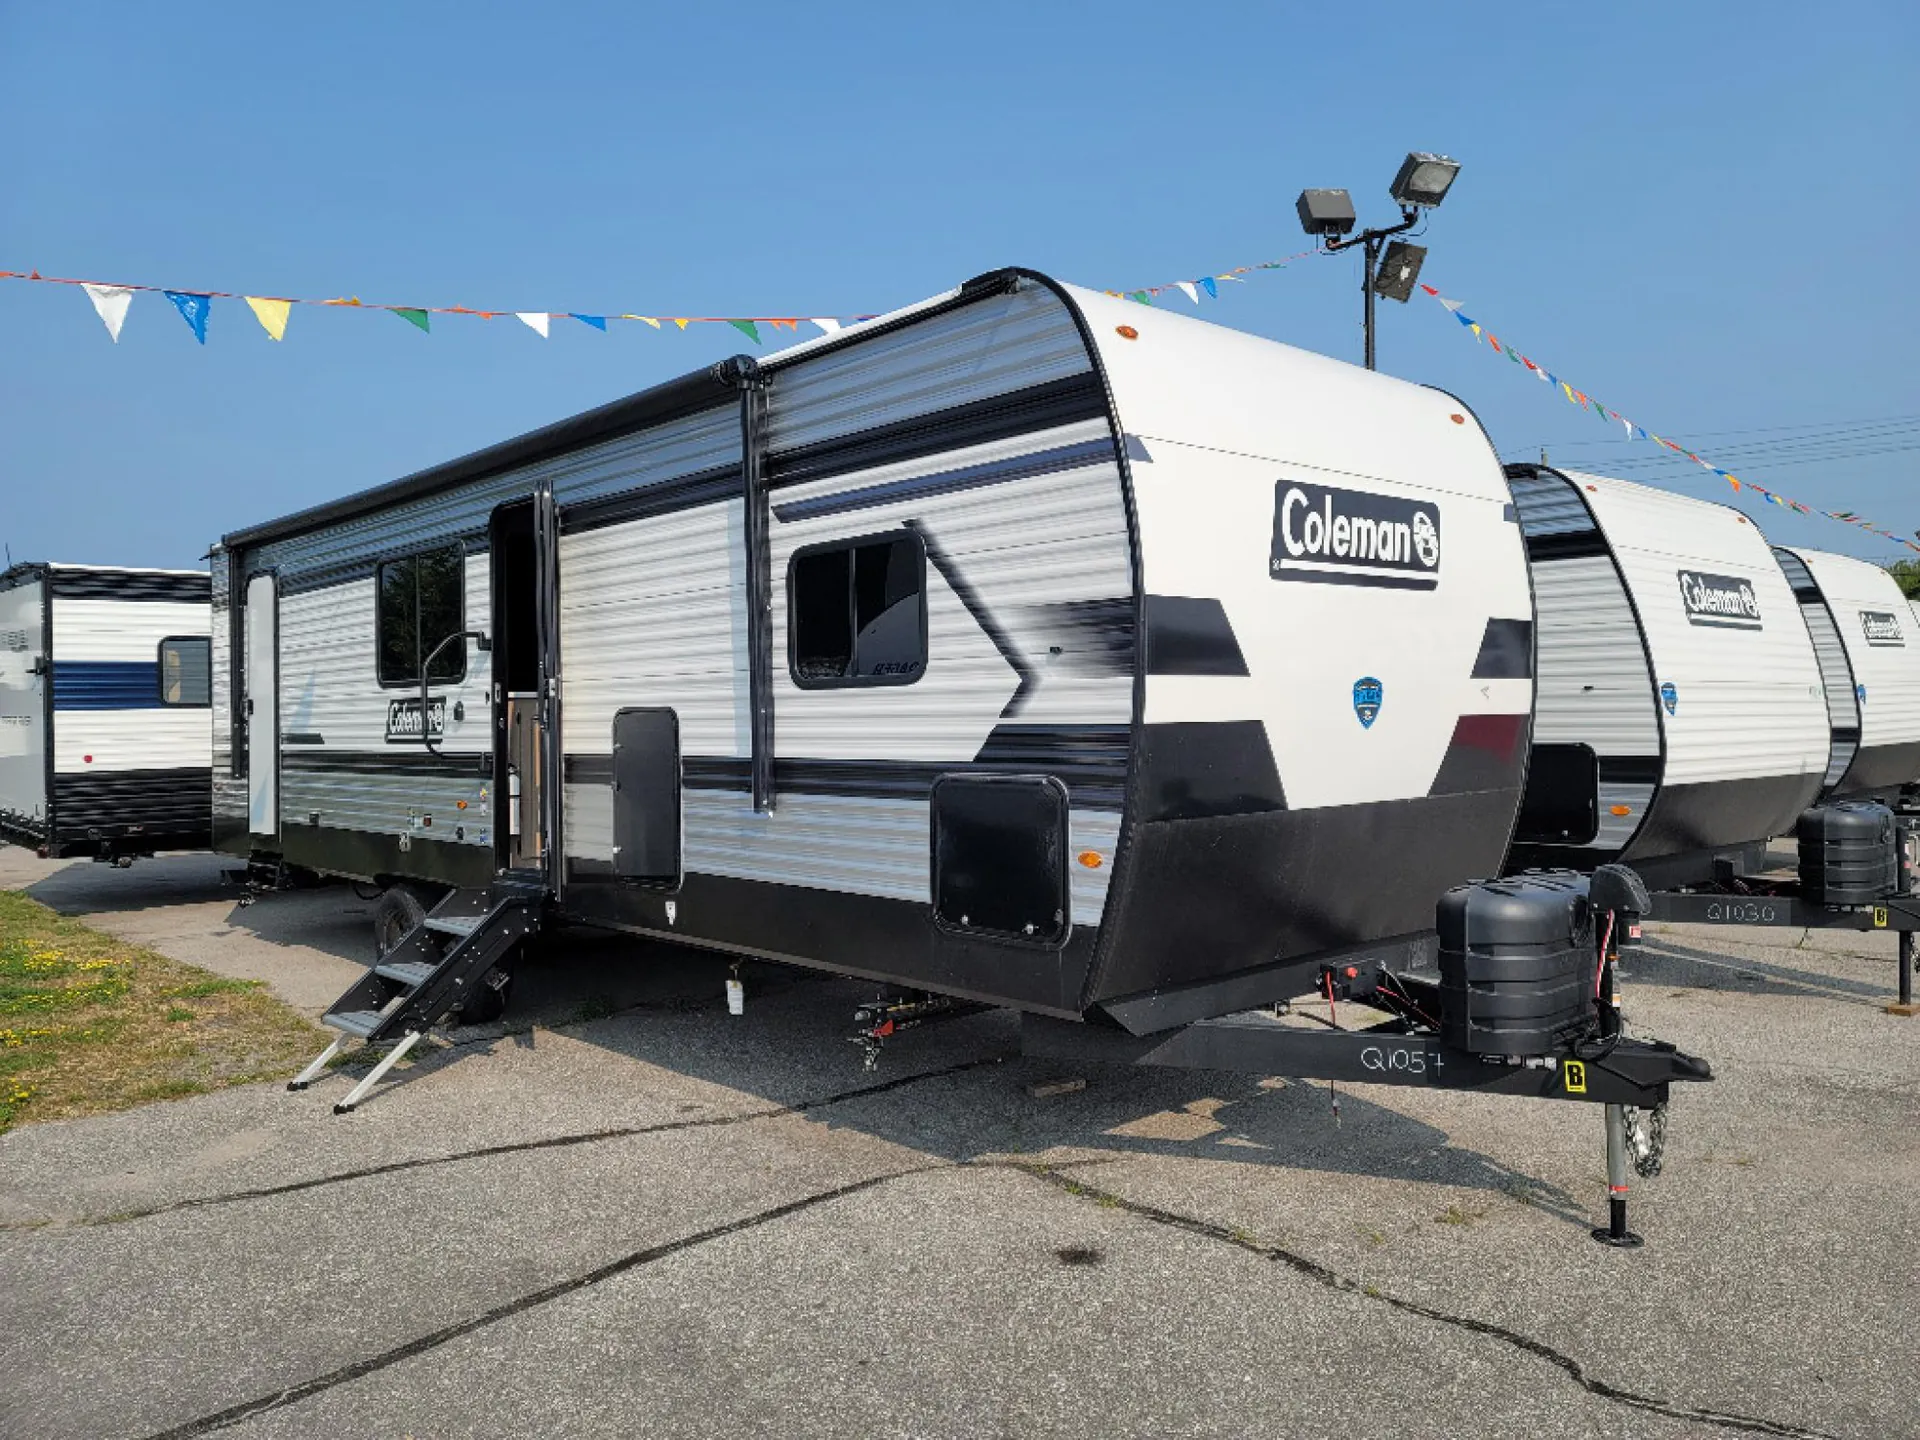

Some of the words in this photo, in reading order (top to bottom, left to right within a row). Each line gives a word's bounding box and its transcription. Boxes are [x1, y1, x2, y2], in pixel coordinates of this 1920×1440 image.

[1282, 487, 1411, 563] Coleman
[1681, 573, 1747, 615] Coleman
[390, 702, 434, 733] Colemn
[1707, 902, 1775, 922] Q1030
[1360, 1045, 1445, 1078] Q1057
[1567, 1064, 1583, 1086] B
